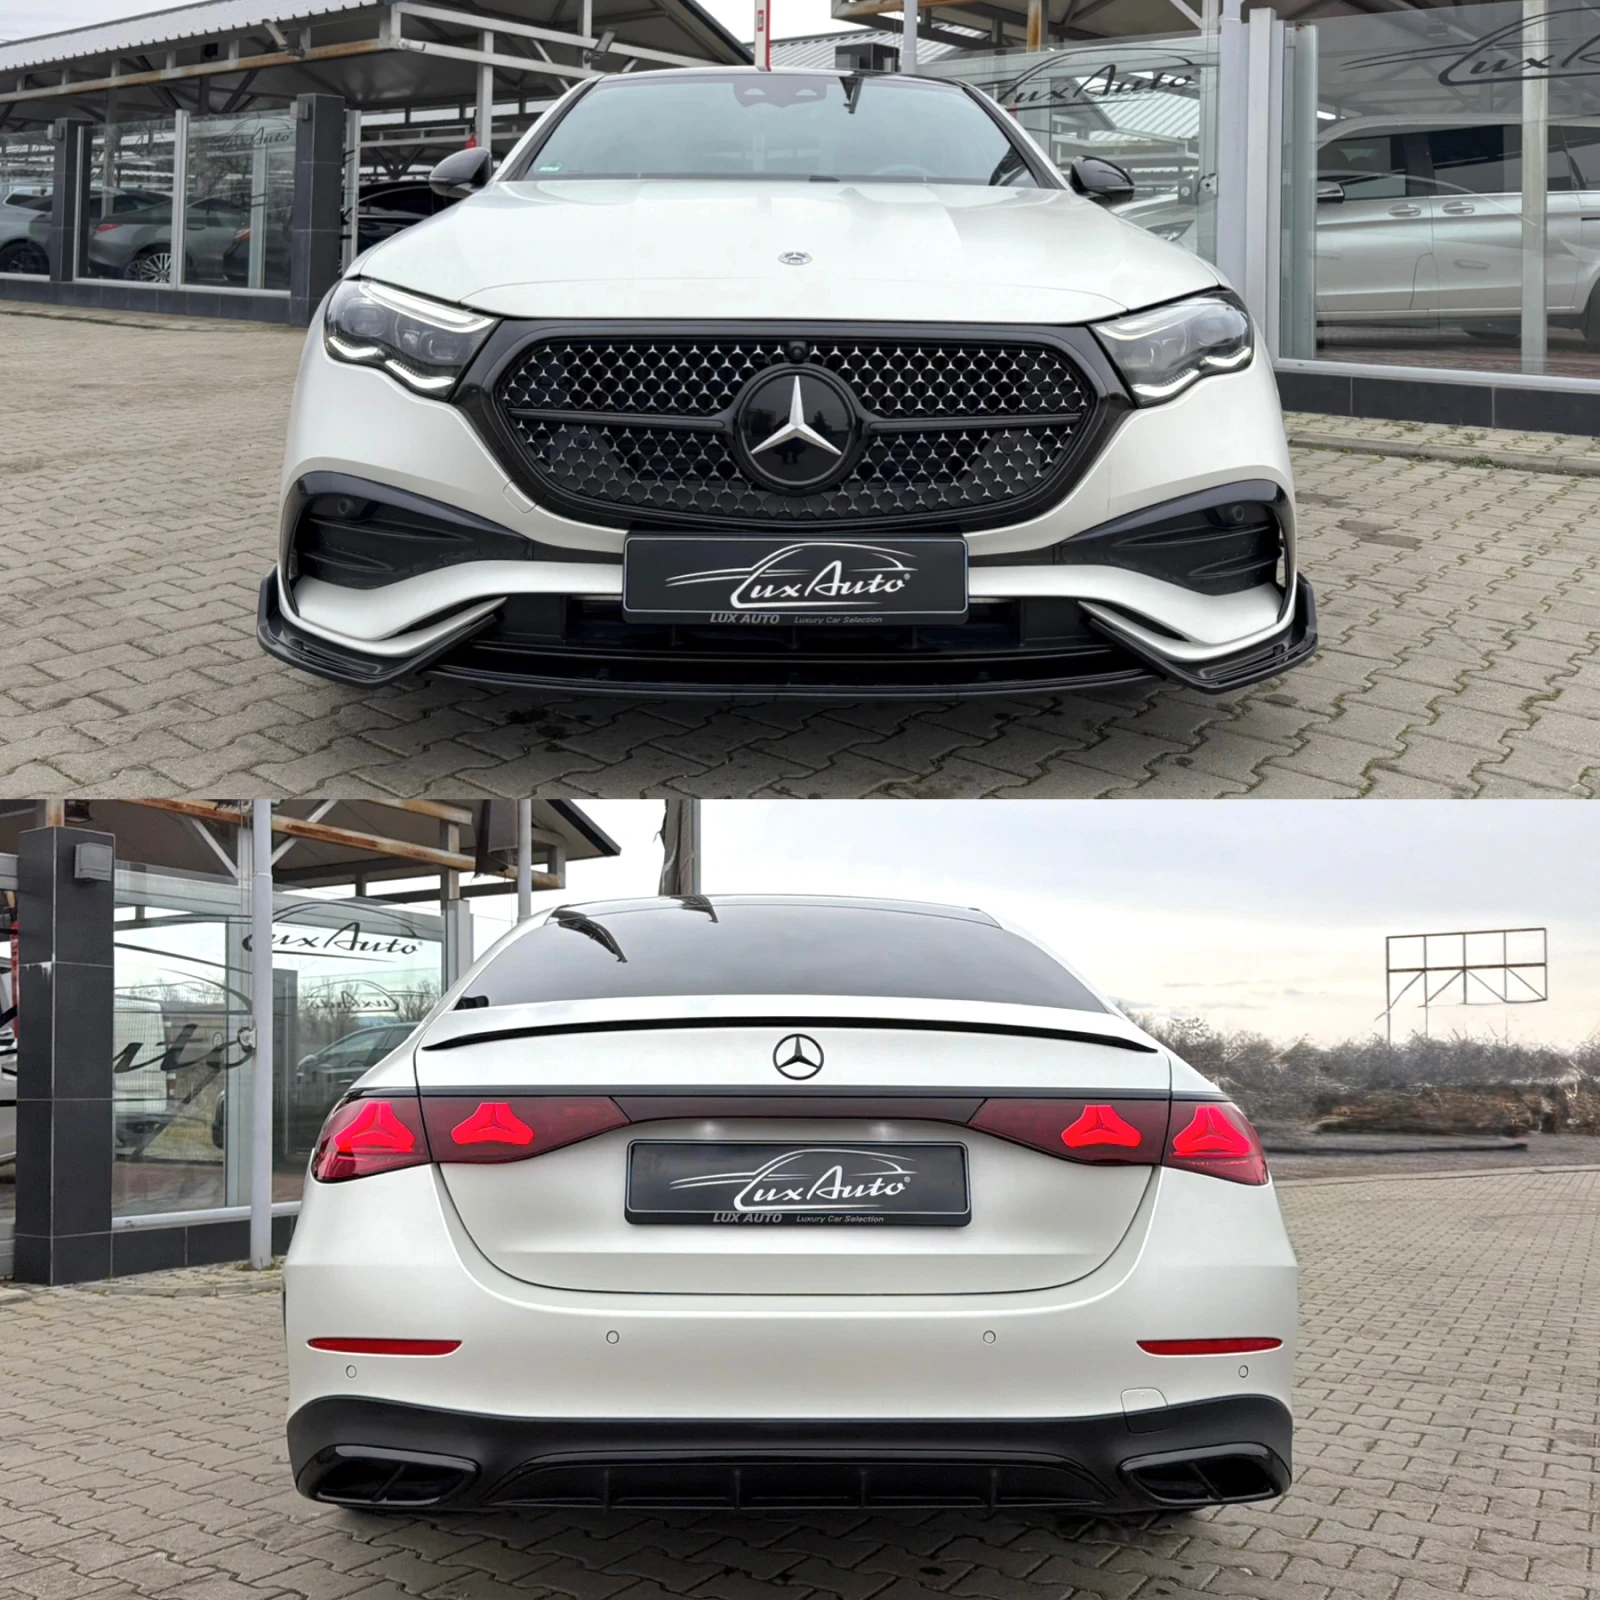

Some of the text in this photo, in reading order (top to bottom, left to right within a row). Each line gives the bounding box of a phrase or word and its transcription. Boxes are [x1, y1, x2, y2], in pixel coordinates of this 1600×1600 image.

[710, 613, 884, 625] LUX AUTO Luxury Car Selection
[712, 1212, 886, 1225] LUX AUTO Luxury Car Selection
